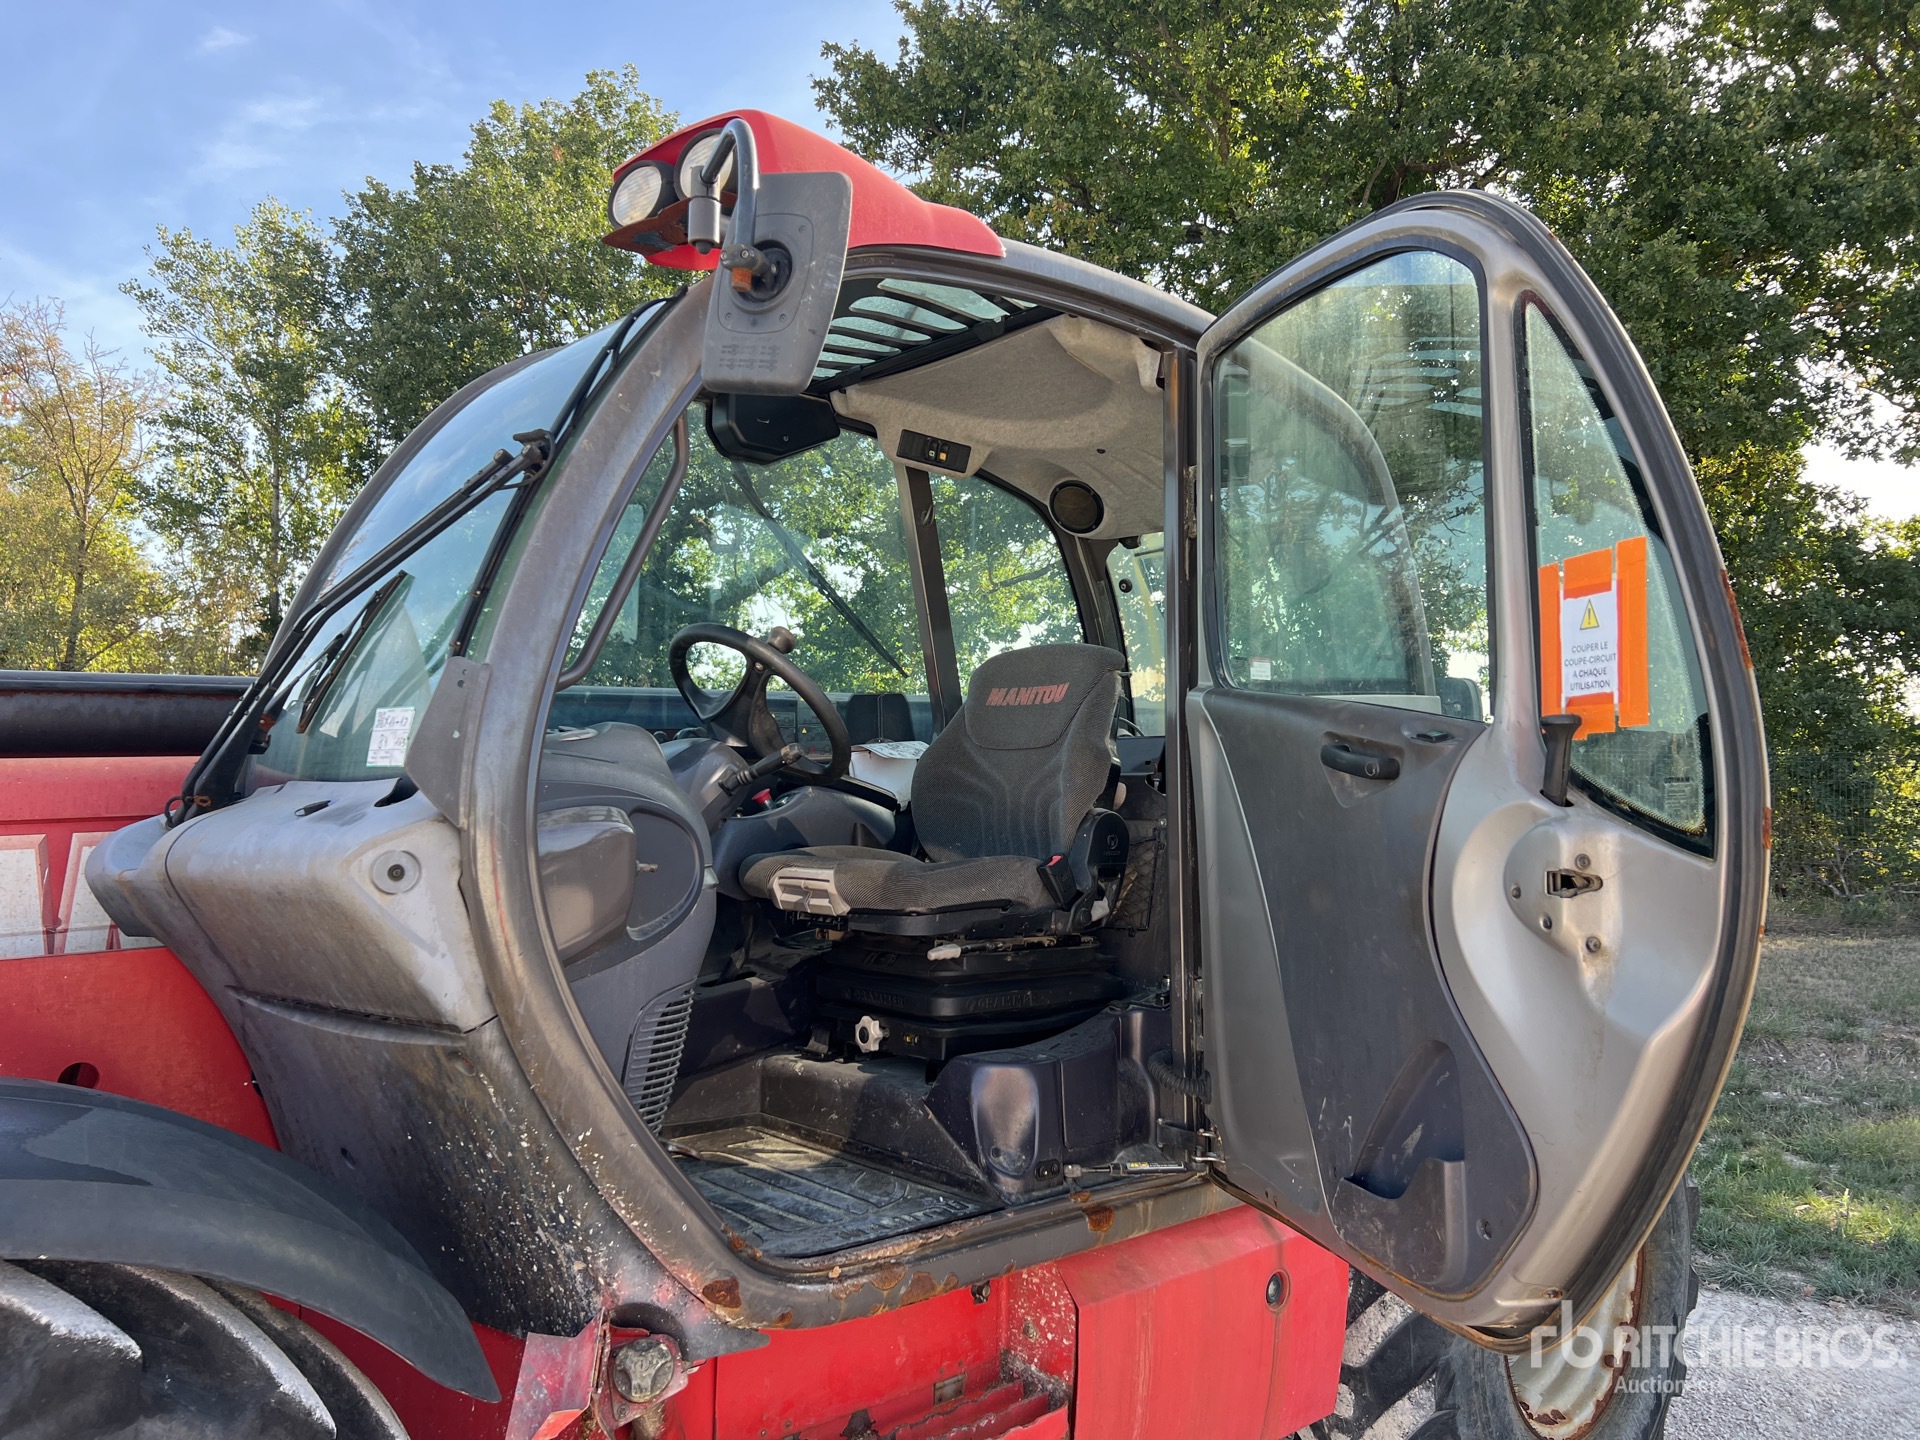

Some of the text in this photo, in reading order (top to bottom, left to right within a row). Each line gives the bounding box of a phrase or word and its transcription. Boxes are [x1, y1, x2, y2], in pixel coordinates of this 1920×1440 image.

[1571, 641, 1609, 654] COUPER LE
[1564, 652, 1616, 667] COUPE-CIRCUIT
[1578, 667, 1607, 677] CHAQUE
[1570, 680, 1611, 691] UTILISATION
[985, 682, 1070, 706] MANITOU
